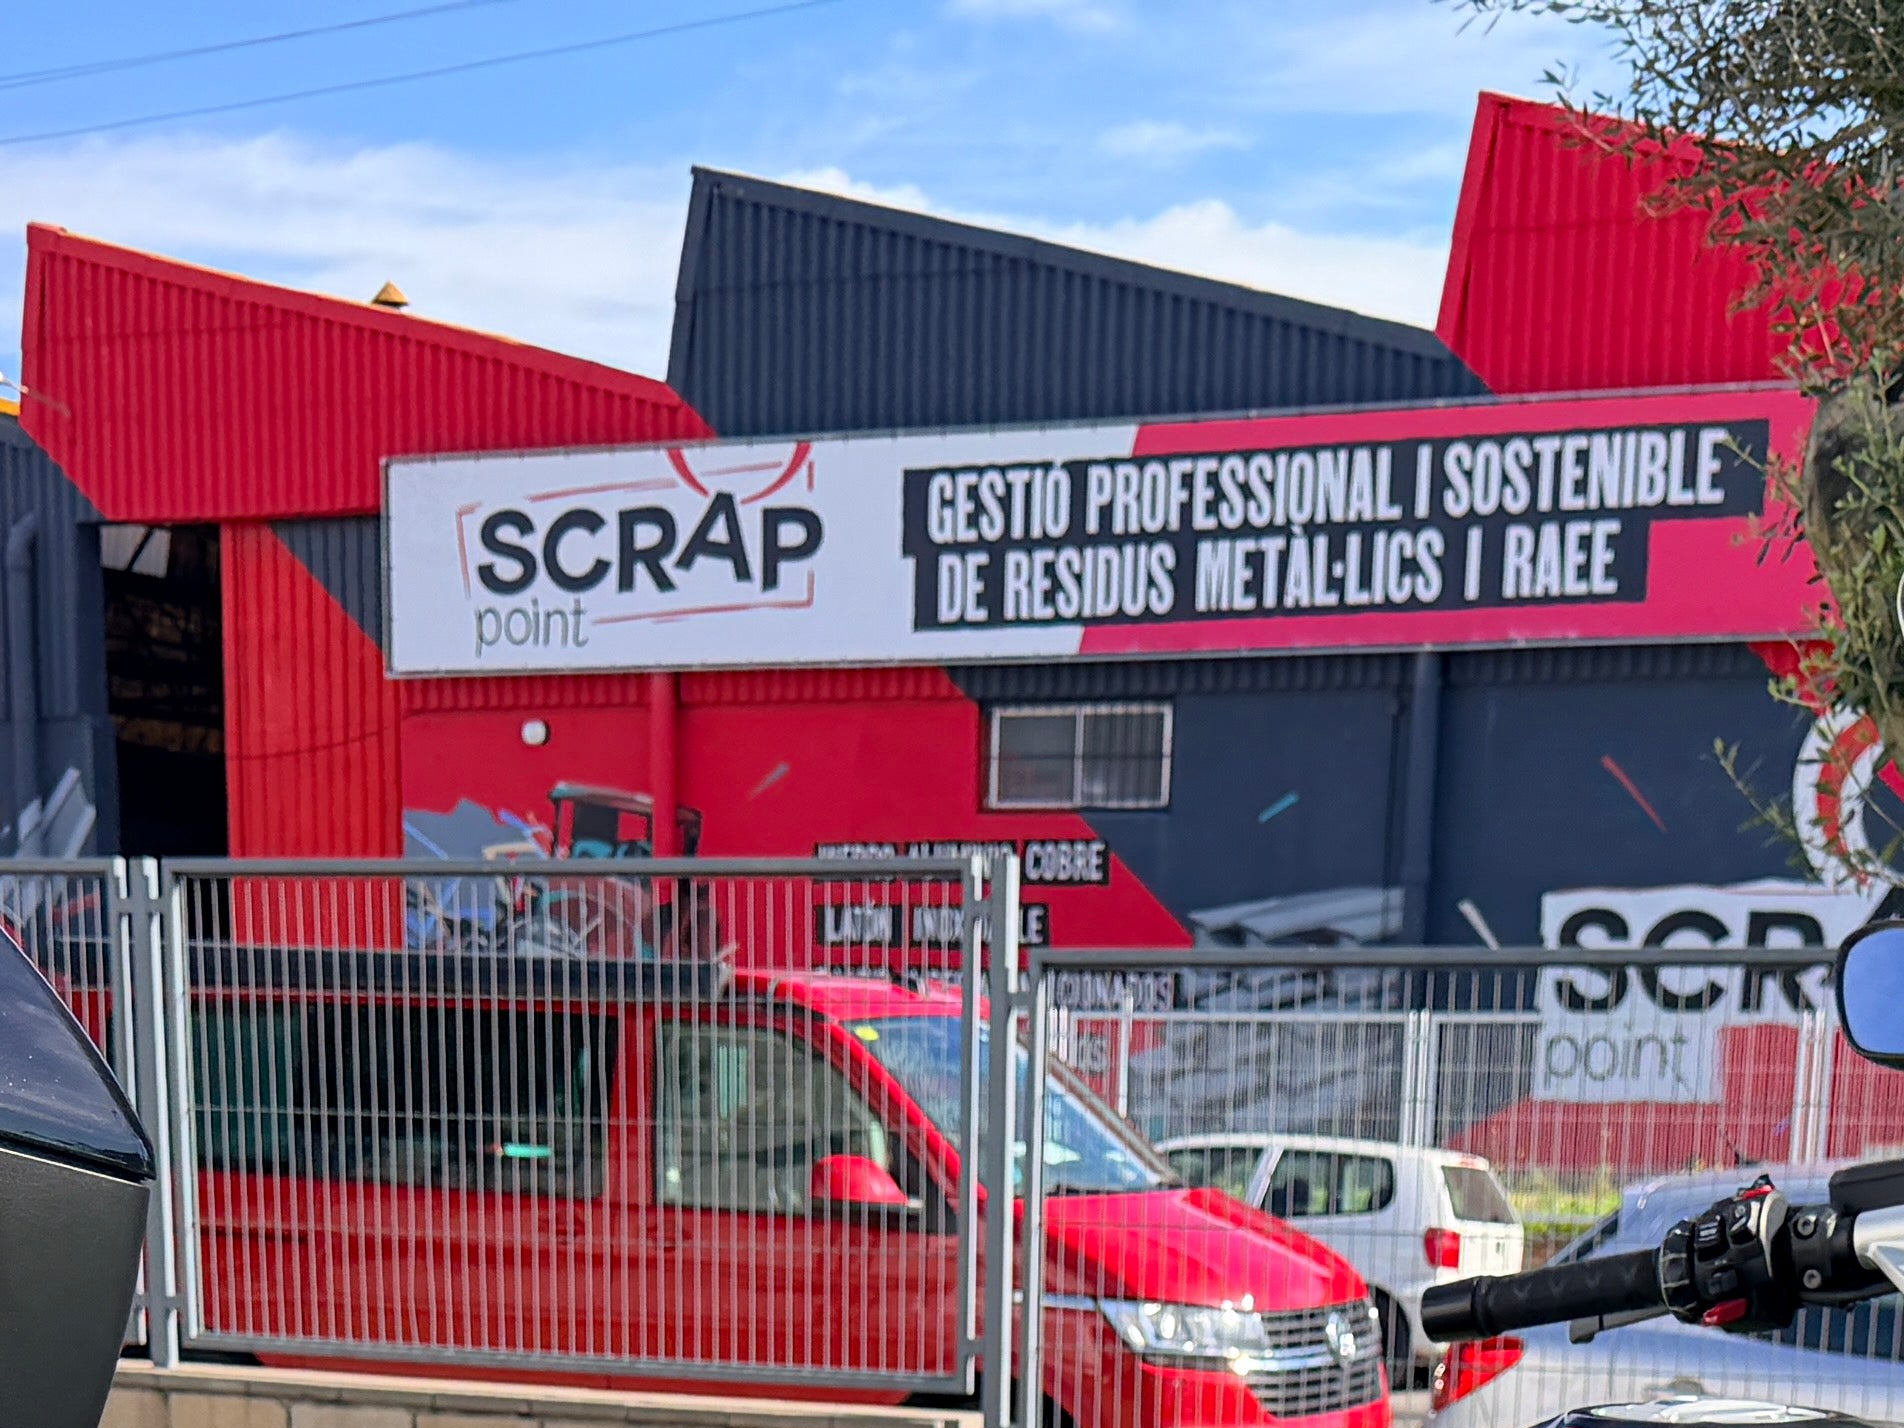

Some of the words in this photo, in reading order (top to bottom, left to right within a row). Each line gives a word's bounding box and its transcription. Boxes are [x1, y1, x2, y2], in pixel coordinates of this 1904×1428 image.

[927, 458, 1072, 545] GESTIÓ
[1085, 445, 1403, 536] PROFESSIONAL
[1414, 443, 1433, 520] I
[1443, 427, 1729, 518] SOSTENIBLE
[476, 490, 825, 595] SCRAP
[937, 551, 990, 624] DE
[1003, 540, 1176, 621] RESIDUS
[1464, 524, 1483, 601] I
[1502, 518, 1622, 599] RAEE
[474, 597, 590, 658] point
[1024, 840, 1109, 882] COBRE
[1544, 1022, 1692, 1091] point
